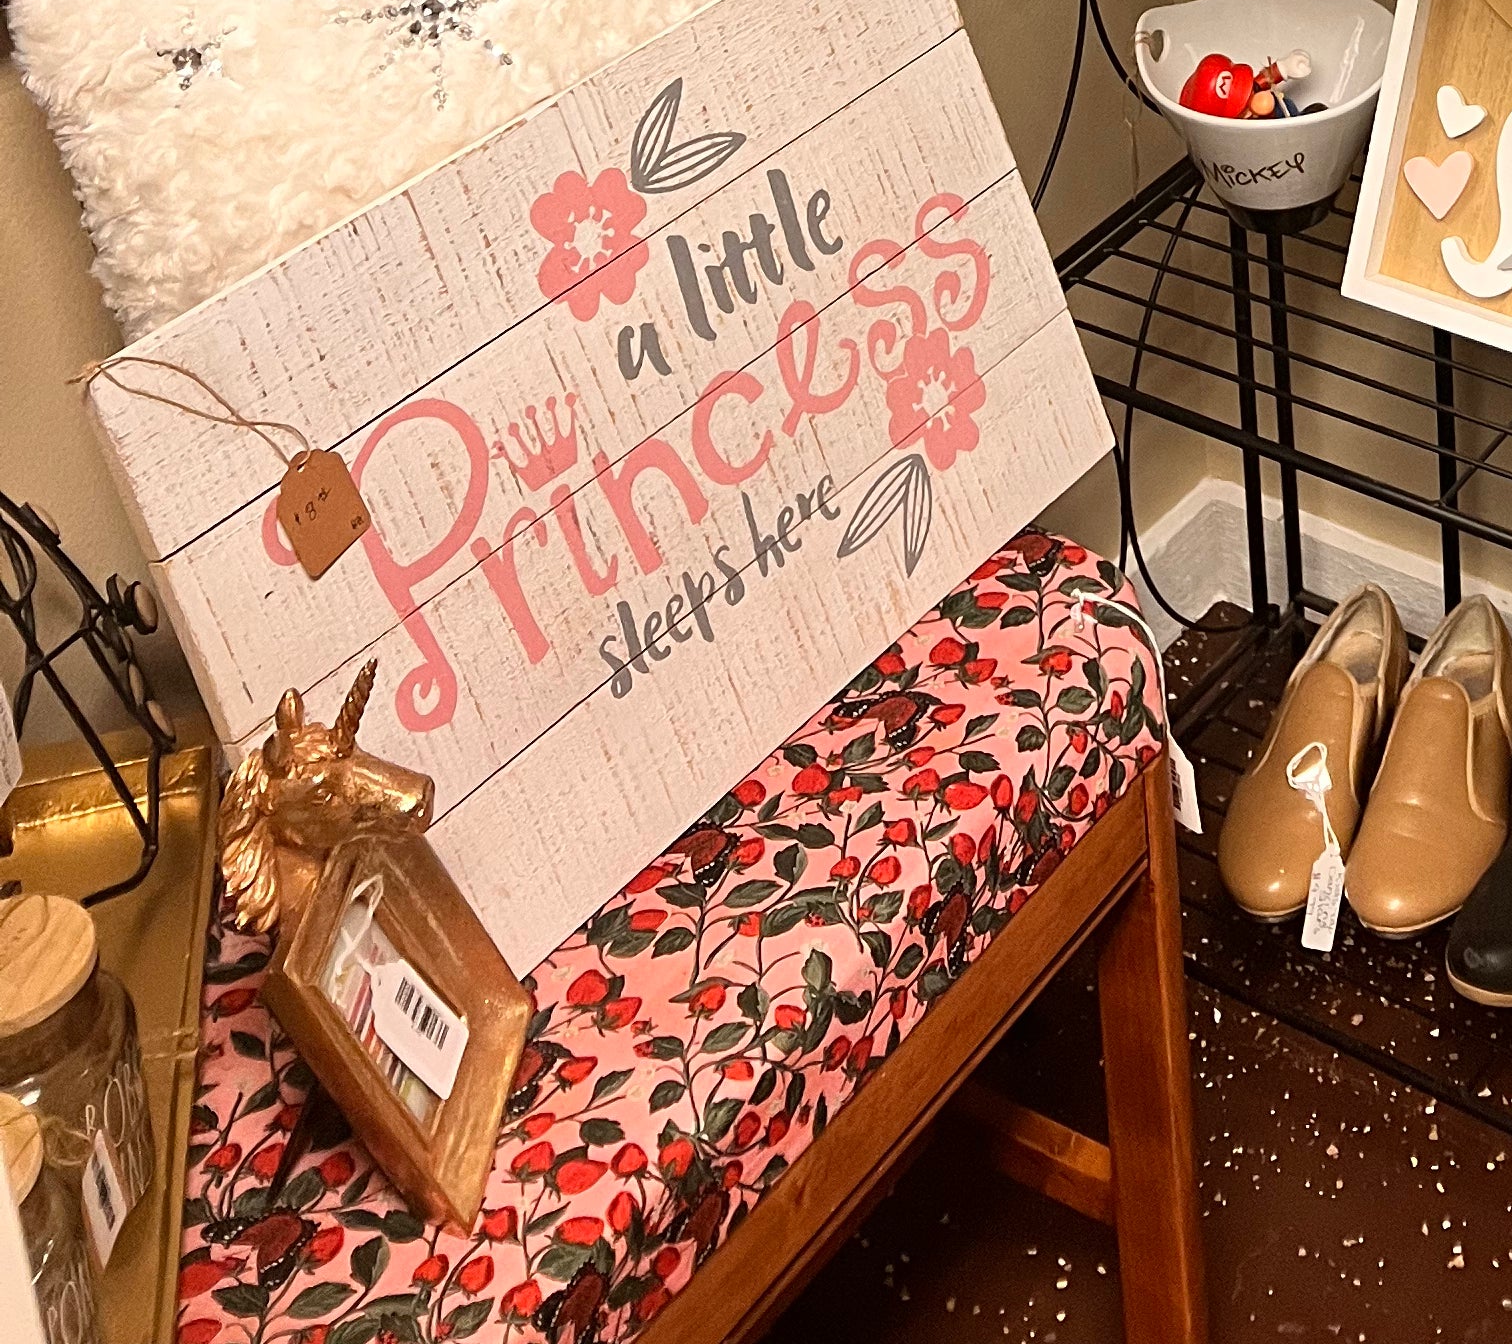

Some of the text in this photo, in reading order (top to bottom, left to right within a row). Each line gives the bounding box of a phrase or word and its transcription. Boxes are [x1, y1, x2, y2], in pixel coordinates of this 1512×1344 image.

[617, 169, 843, 380] a little
[261, 193, 991, 732] Princess
[600, 474, 841, 698] sleeps here
